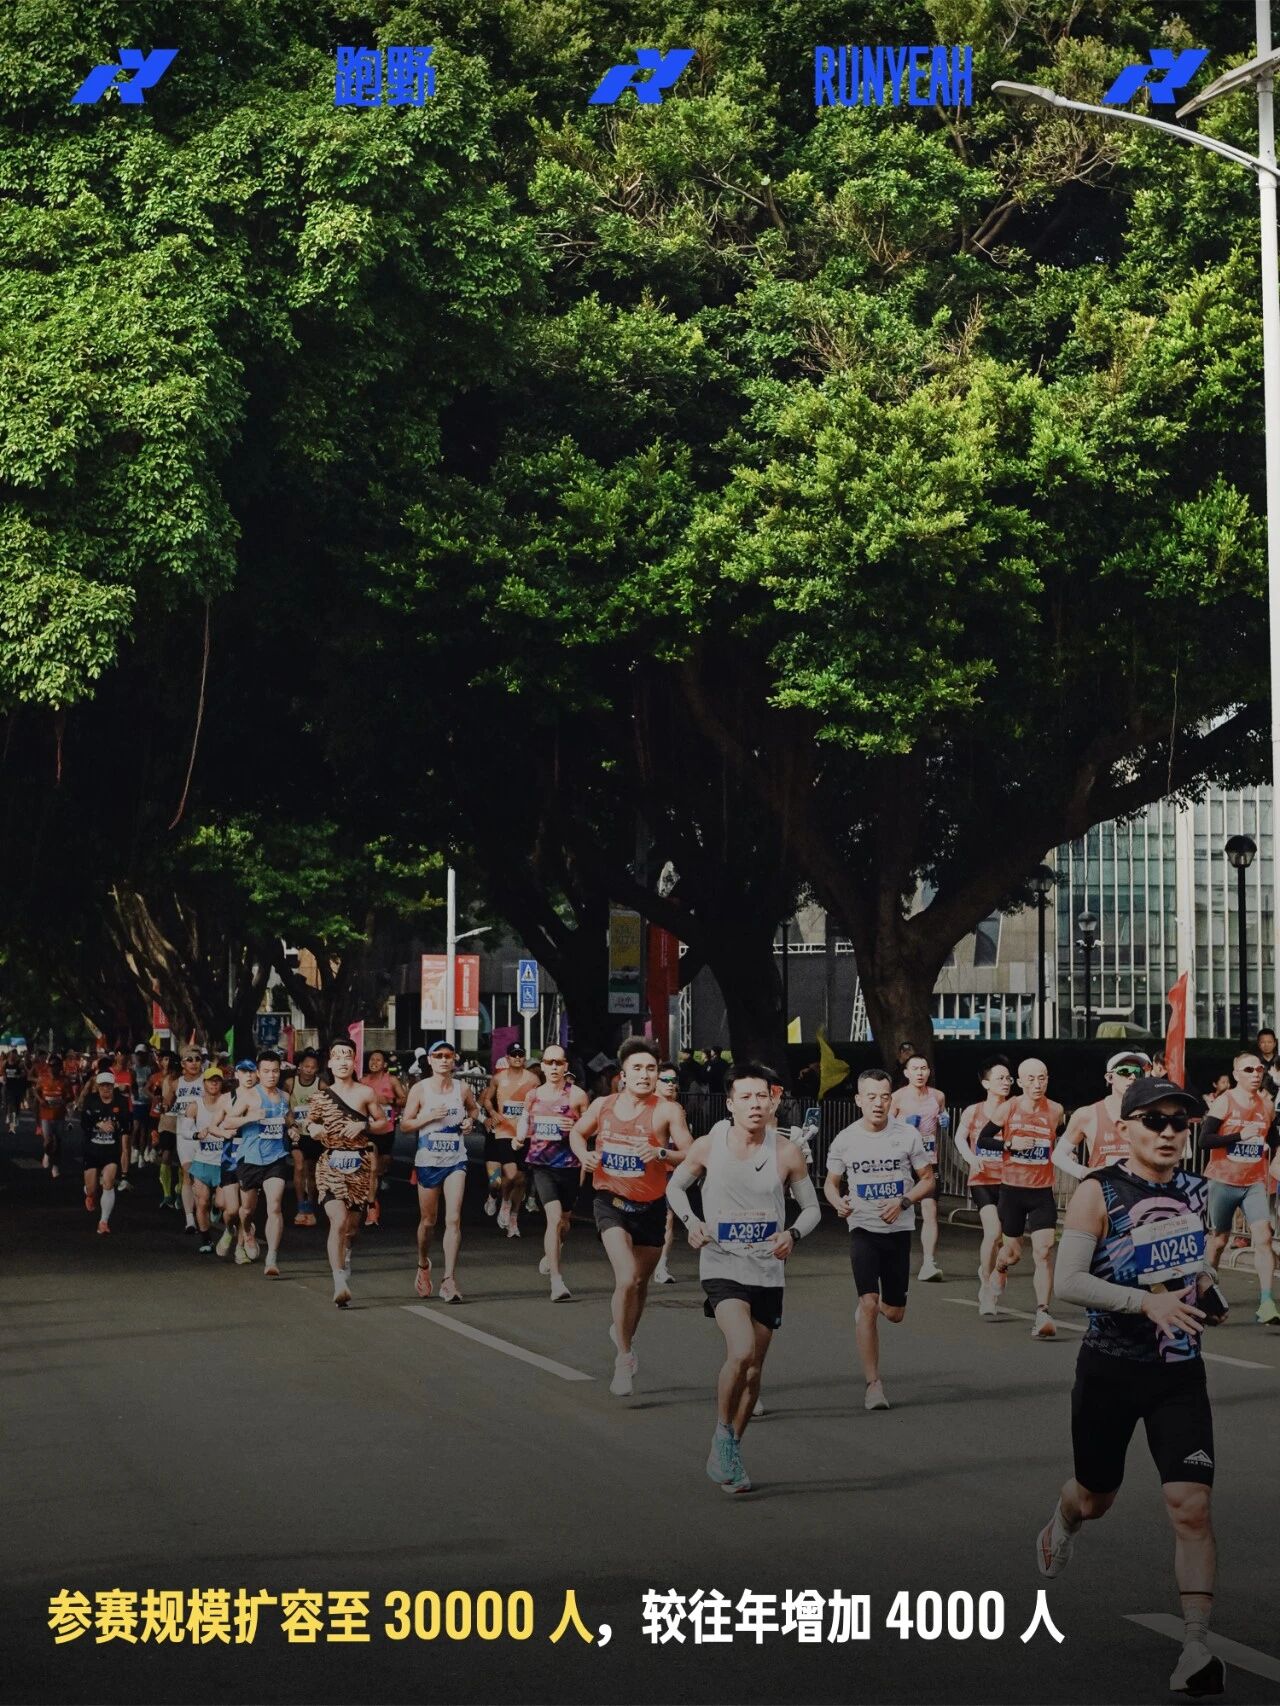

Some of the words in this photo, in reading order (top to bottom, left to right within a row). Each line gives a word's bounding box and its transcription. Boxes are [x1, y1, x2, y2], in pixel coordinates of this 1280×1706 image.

[606, 1154, 637, 1168] A1918
[852, 1159, 901, 1174] POLICE
[865, 1182, 897, 1197] A1468
[728, 1223, 768, 1240] A2937
[1151, 1234, 1198, 1266] A0246
